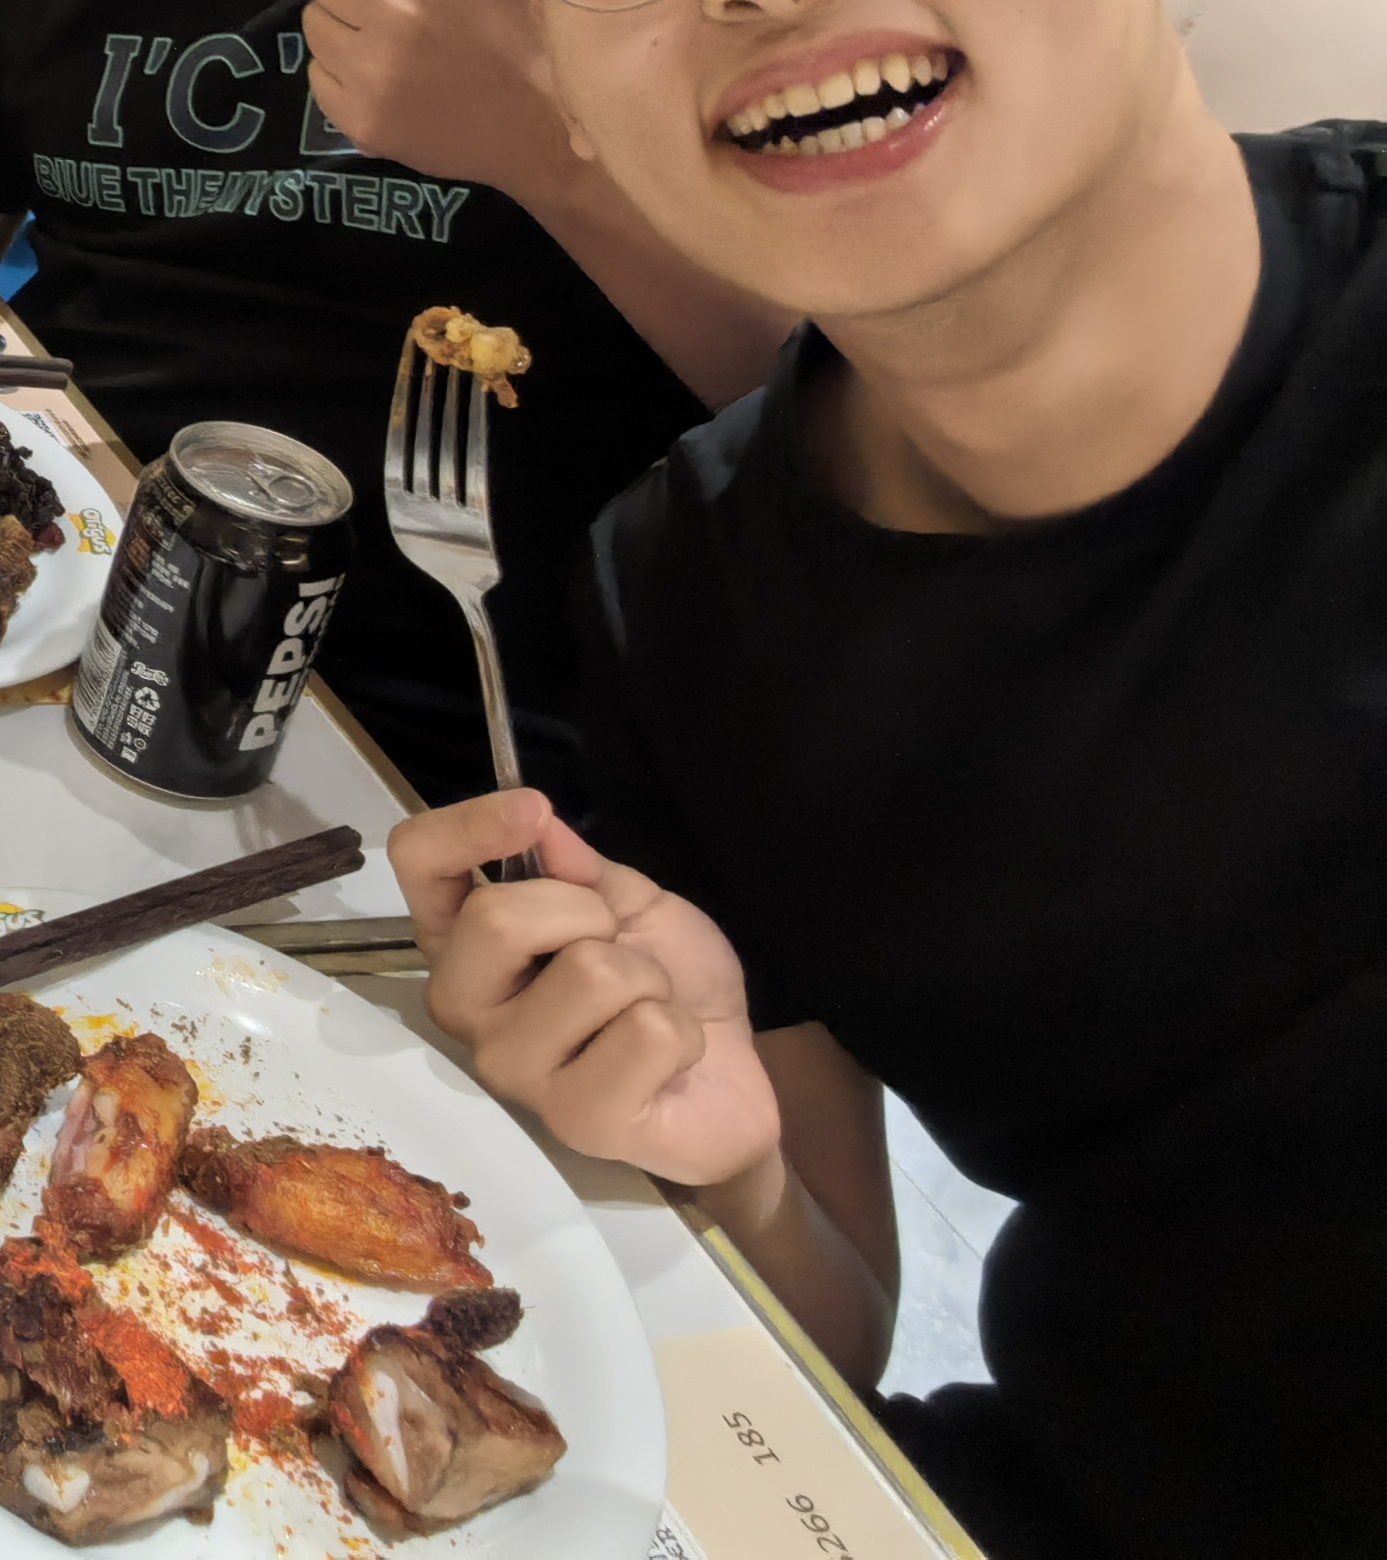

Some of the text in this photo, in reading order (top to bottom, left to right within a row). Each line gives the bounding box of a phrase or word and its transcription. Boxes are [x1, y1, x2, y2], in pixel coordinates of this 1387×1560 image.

[239, 577, 337, 751] PEPSI
[721, 1411, 855, 1560] 266 185
